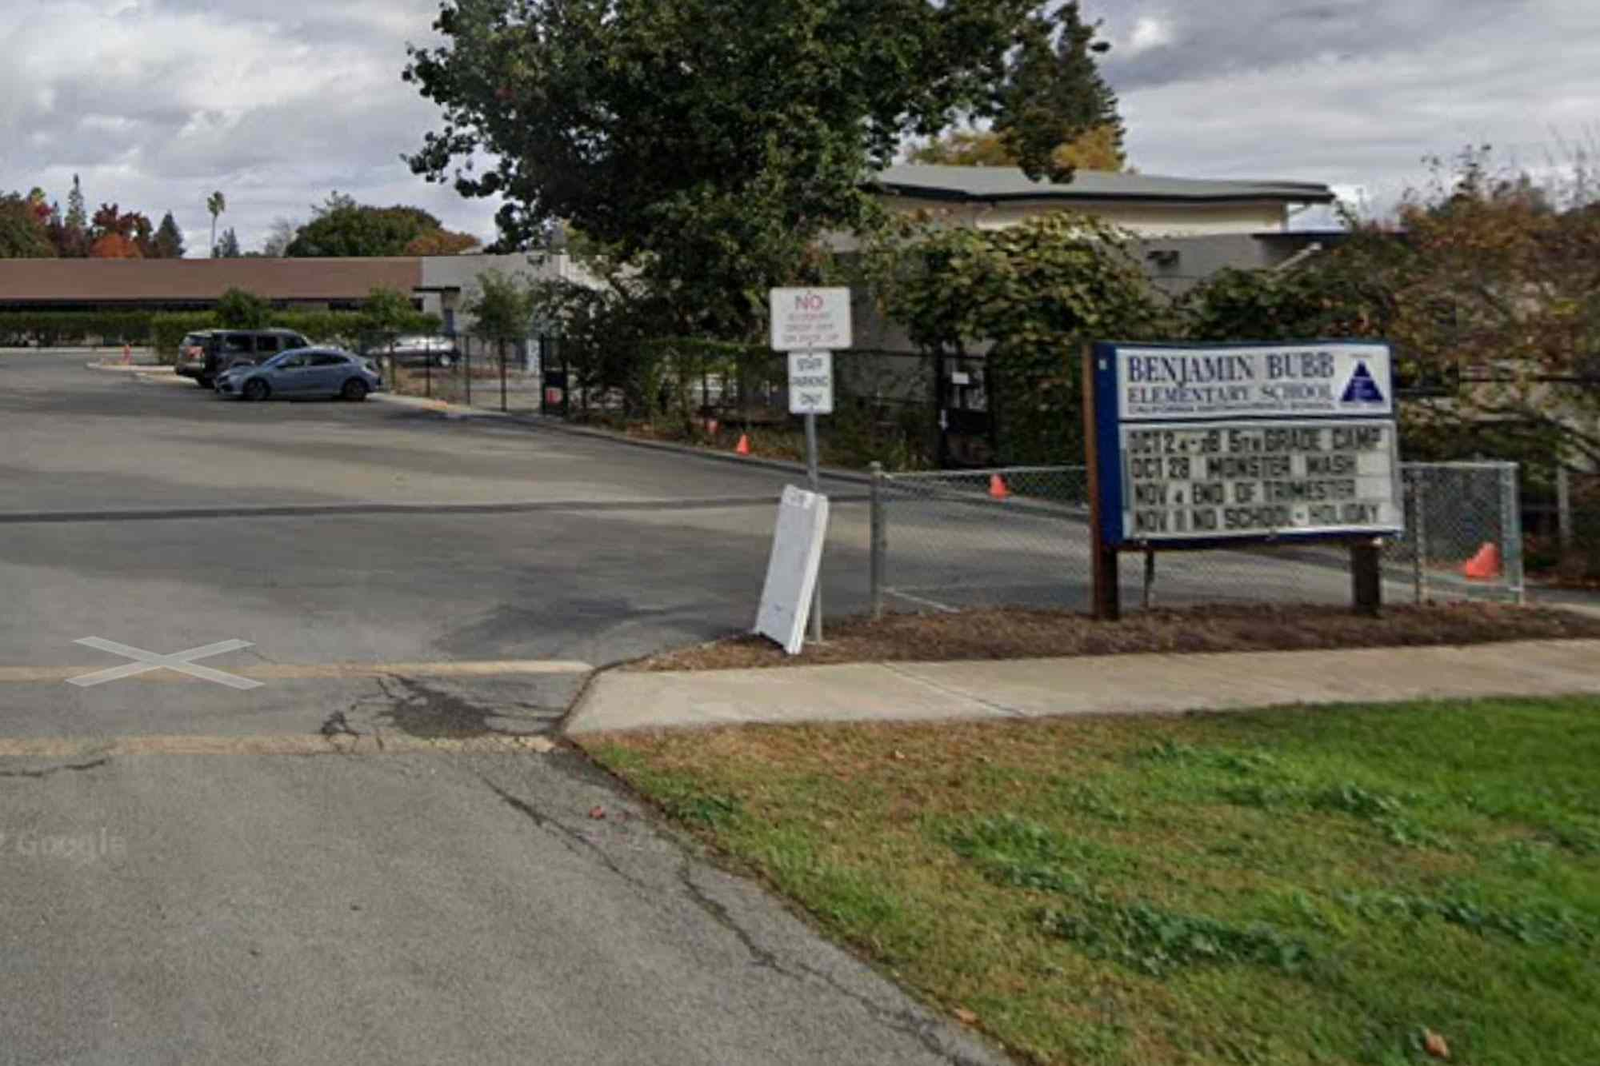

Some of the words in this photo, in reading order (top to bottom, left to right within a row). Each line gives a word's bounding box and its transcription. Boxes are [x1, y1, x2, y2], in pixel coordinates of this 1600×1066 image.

[795, 295, 824, 310] NO
[1129, 355, 1255, 387] BENJAMIN
[1267, 352, 1335, 380] BUBB
[1127, 387, 1249, 404] ELEMENTARY
[1259, 382, 1333, 400] SCHOOL
[1130, 430, 1161, 454] OCT
[1265, 427, 1321, 451] GRADE
[1331, 425, 1382, 450] CAMP
[1132, 457, 1162, 478] OCT
[1168, 457, 1190, 478] 28
[1207, 455, 1290, 478] MONSTER
[1135, 484, 1167, 505] NOV
[1192, 482, 1224, 504] END
[1235, 482, 1256, 502] OF
[1263, 479, 1355, 502] TRIMESTER
[1136, 510, 1167, 531] NOV
[1194, 509, 1217, 530] NO
